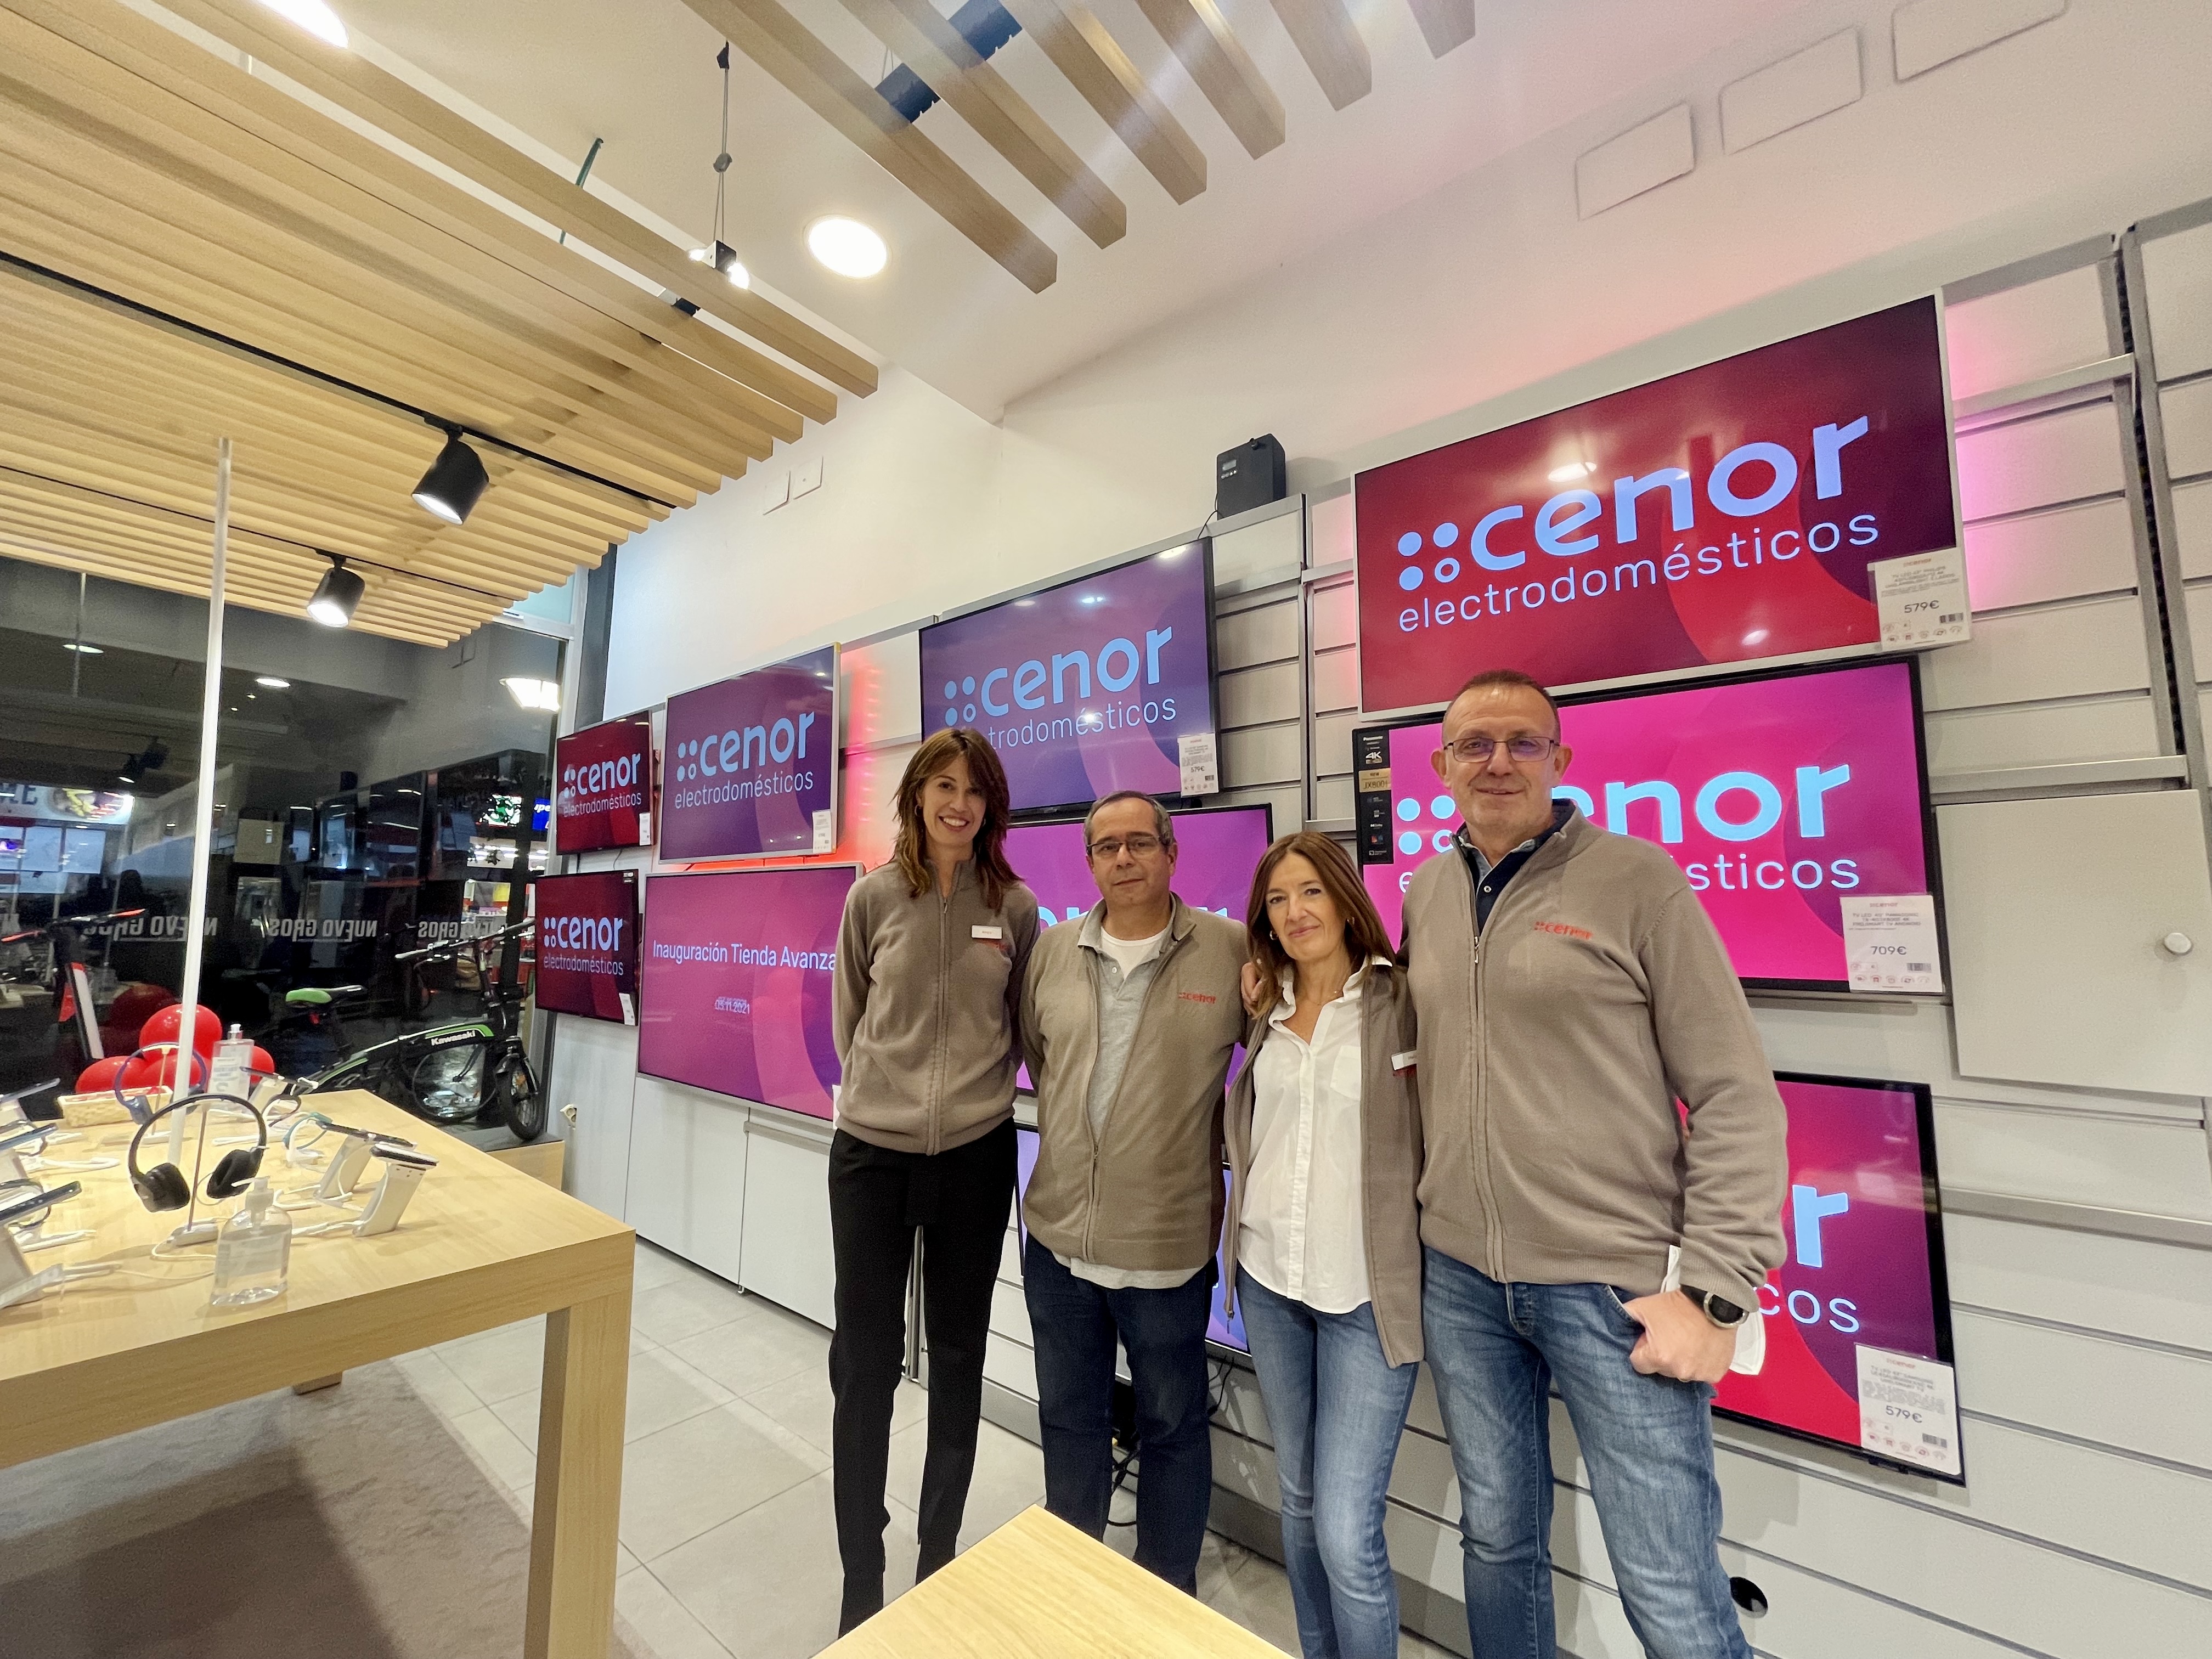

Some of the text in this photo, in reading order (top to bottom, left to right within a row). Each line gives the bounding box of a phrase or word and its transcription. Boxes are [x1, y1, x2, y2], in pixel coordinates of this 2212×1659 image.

[1471, 415, 1868, 571] cenor
[1398, 512, 1879, 631] electrodomésticos
[1904, 600, 1939, 613] 579€
[981, 626, 1172, 716] cenor
[988, 698, 1176, 750] trodomésticos
[700, 711, 815, 777] cenor
[1365, 751, 1381, 759] 4K
[577, 752, 641, 795] cenor
[675, 771, 814, 810] electrodomésticos
[563, 791, 642, 817] electrodomésticos
[1551, 764, 1850, 844] nor
[557, 916, 624, 951] cenor
[1871, 946, 1907, 955] 709€
[544, 952, 624, 976] electrodomésticos
[653, 940, 727, 965] Inauguración
[731, 943, 777, 967] Tienda
[431, 1030, 476, 1046] Kawasaki
[1886, 1405, 1923, 1424] 579€
